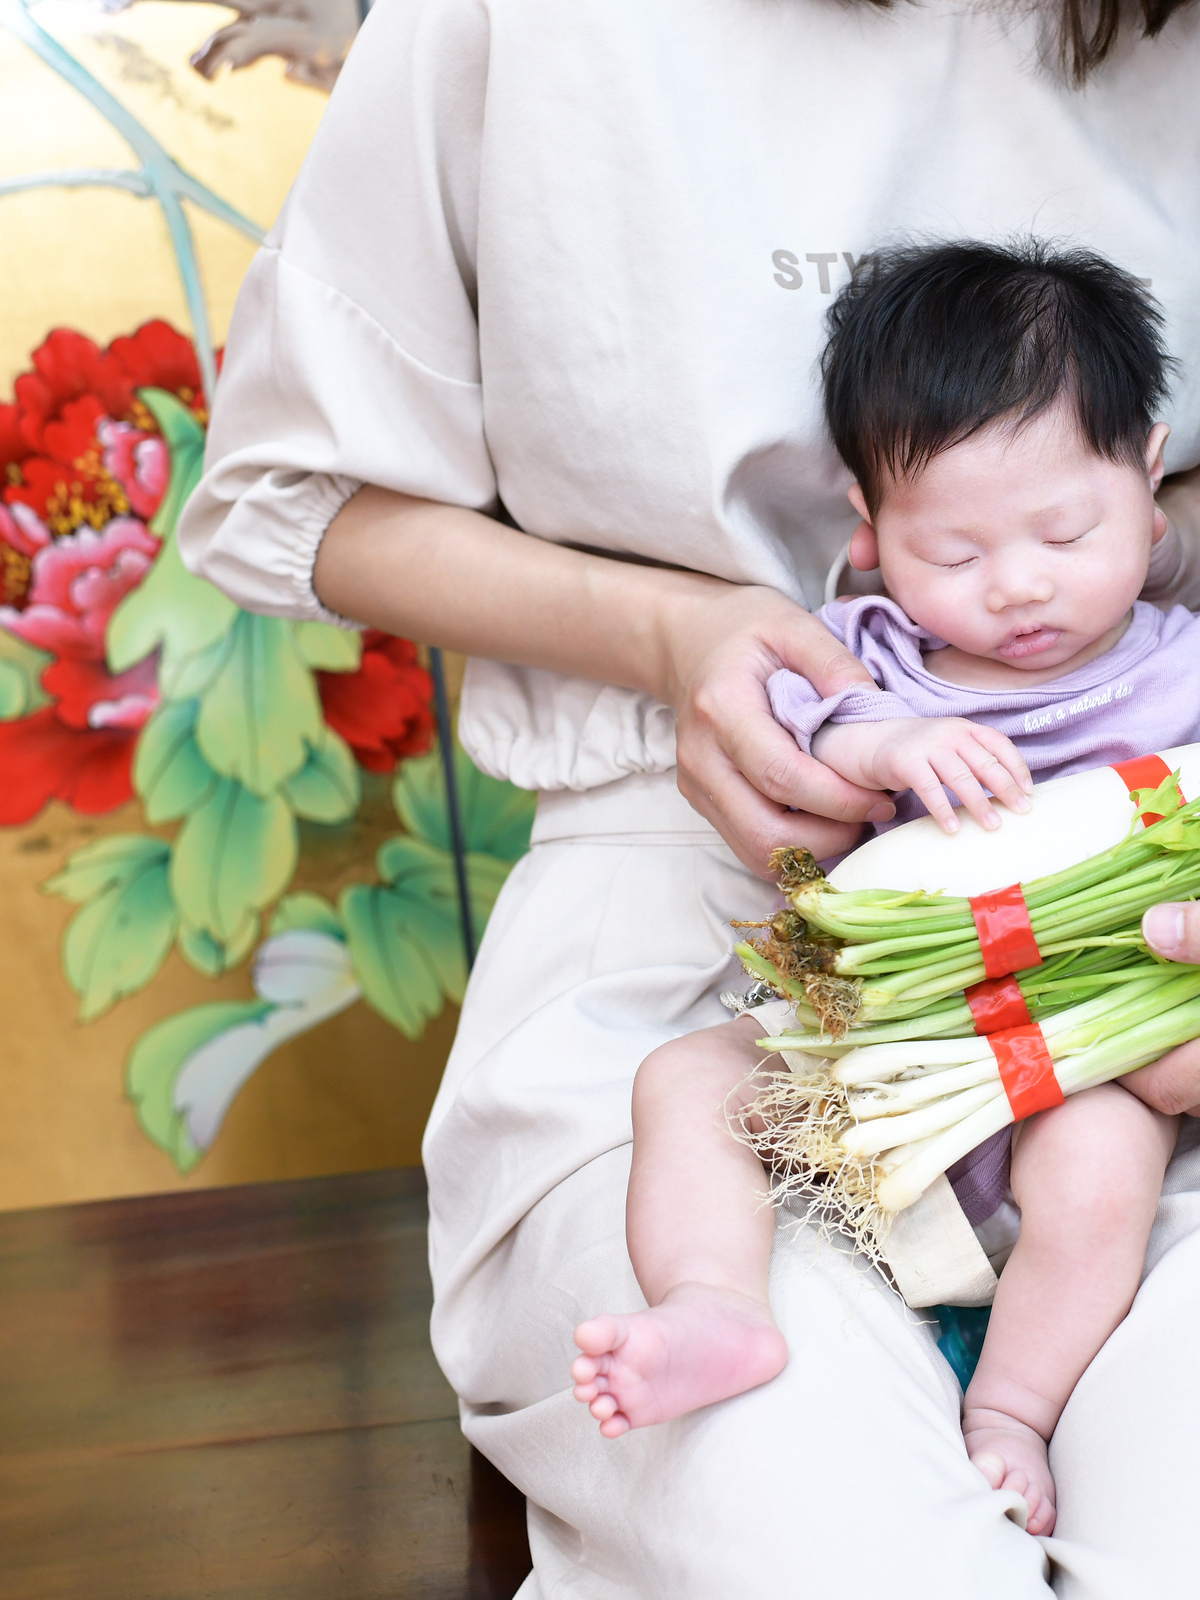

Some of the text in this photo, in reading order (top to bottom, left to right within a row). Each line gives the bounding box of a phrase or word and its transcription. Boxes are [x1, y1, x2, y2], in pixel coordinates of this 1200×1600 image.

[1025, 711, 1053, 733] have
[1056, 708, 1066, 720] a
[1070, 687, 1113, 715] natural
